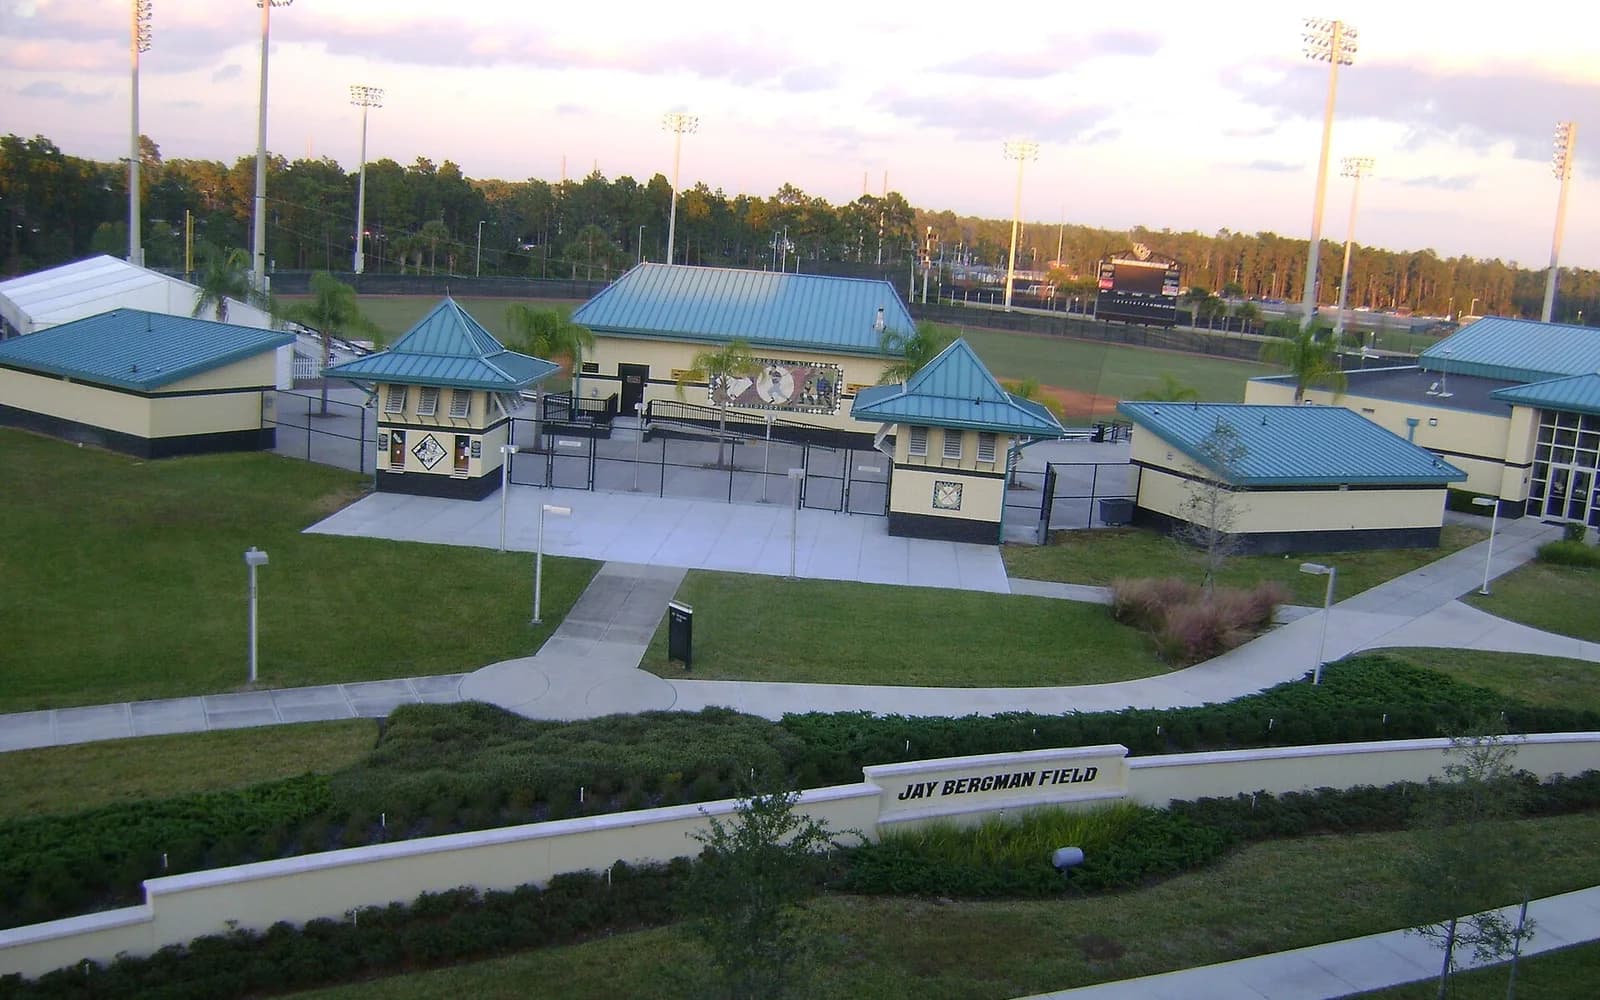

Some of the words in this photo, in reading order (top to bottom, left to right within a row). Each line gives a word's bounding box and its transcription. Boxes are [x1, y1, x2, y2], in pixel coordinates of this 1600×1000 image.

[898, 781, 938, 800] JAY
[942, 772, 1036, 796] BERGMAN
[1039, 767, 1097, 786] FIELD
